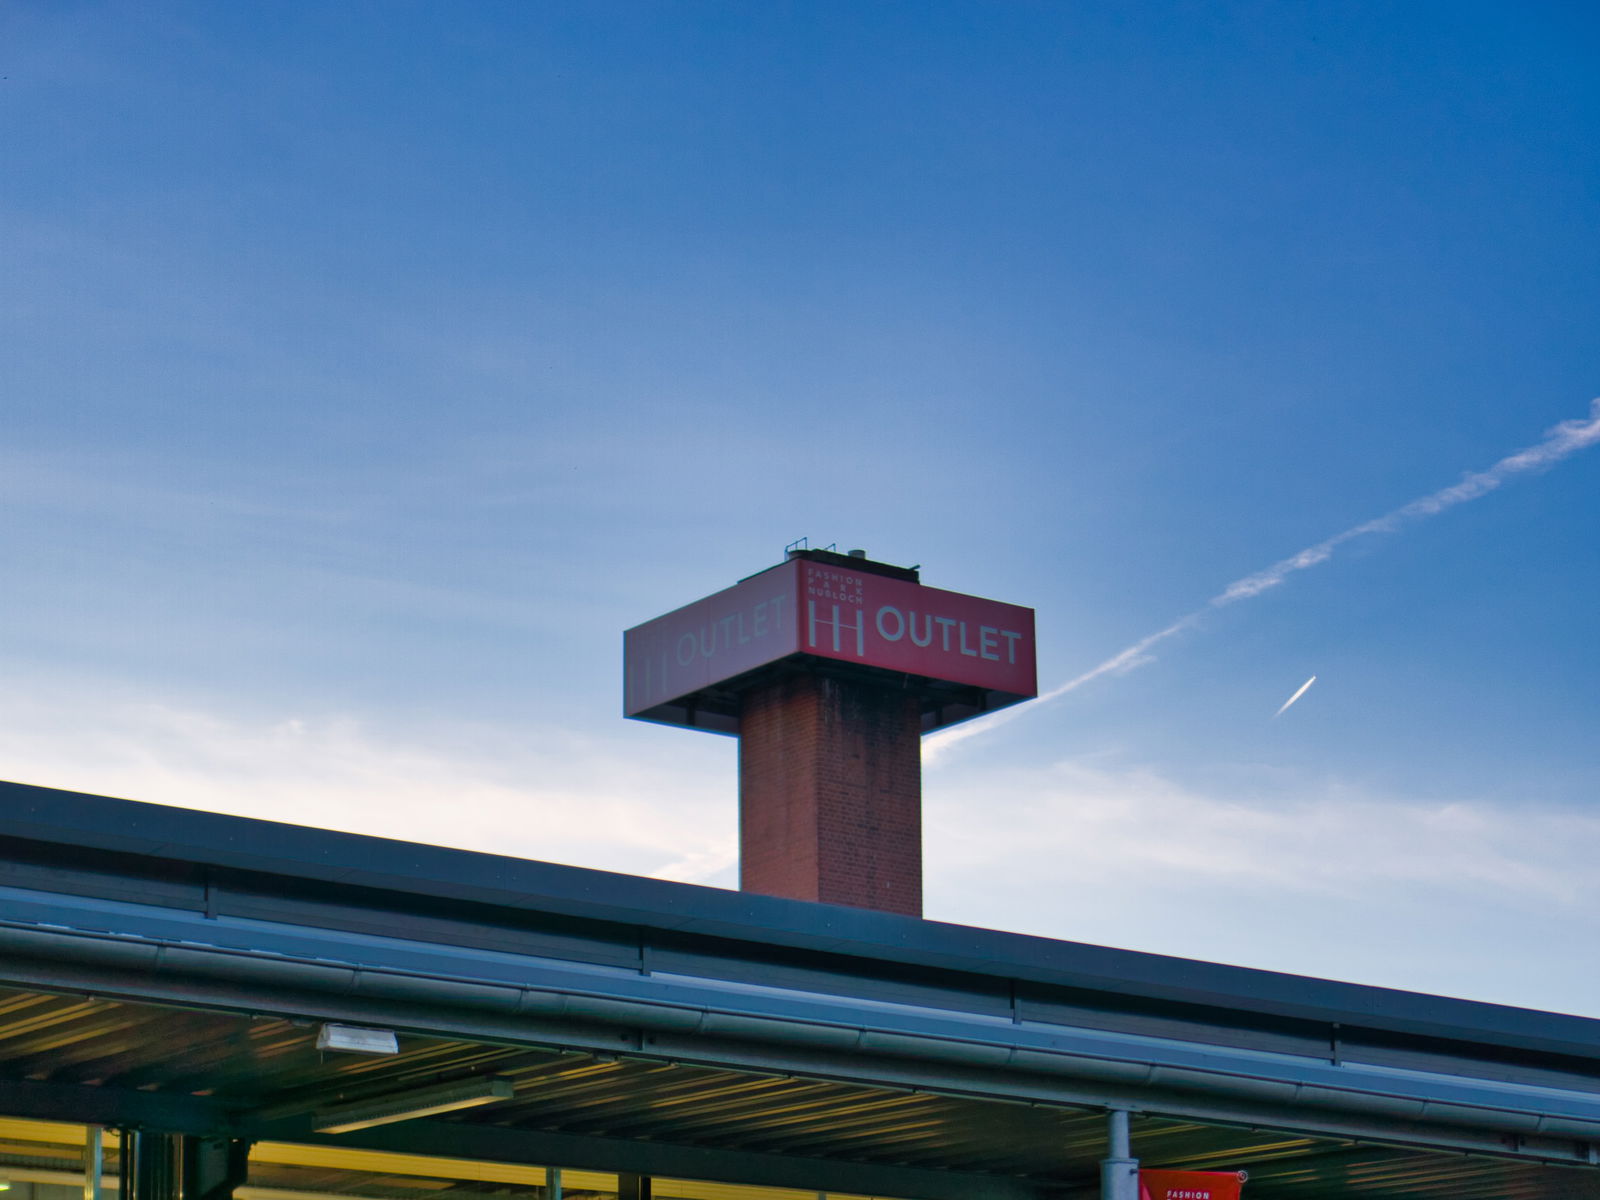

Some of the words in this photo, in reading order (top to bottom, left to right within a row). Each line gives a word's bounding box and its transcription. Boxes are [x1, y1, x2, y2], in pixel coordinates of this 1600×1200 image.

[676, 594, 786, 667] OUTLET
[876, 606, 1022, 664] OUTLET
[1166, 1190, 1209, 1200] FASHION
